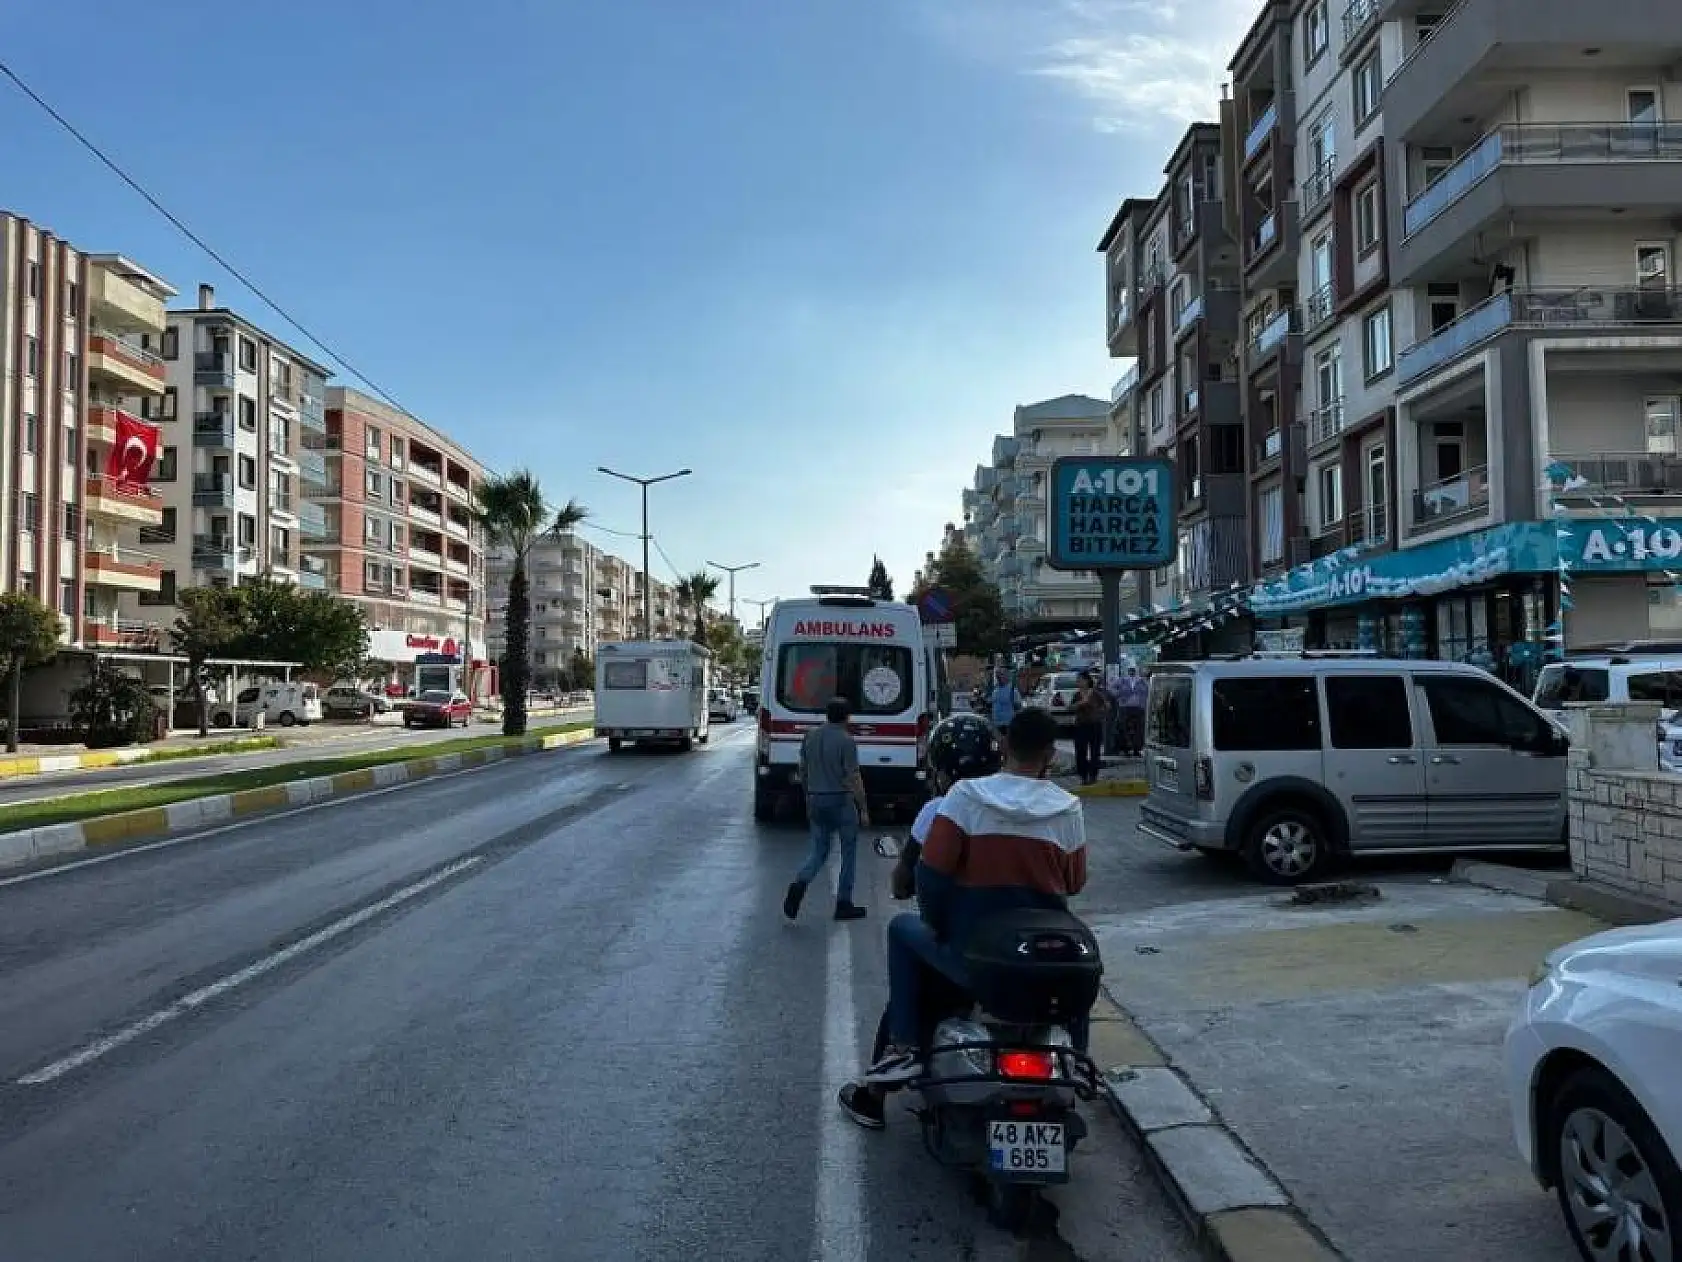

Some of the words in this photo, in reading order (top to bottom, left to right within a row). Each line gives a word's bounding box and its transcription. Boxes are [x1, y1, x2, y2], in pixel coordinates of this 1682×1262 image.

[1070, 496, 1159, 514] HARCA
[1070, 516, 1159, 534] HARCA
[794, 620, 896, 638] AMBULANS
[993, 1123, 1017, 1144] 48
[1025, 1125, 1063, 1145] AKZ
[1011, 1147, 1049, 1169] 685
